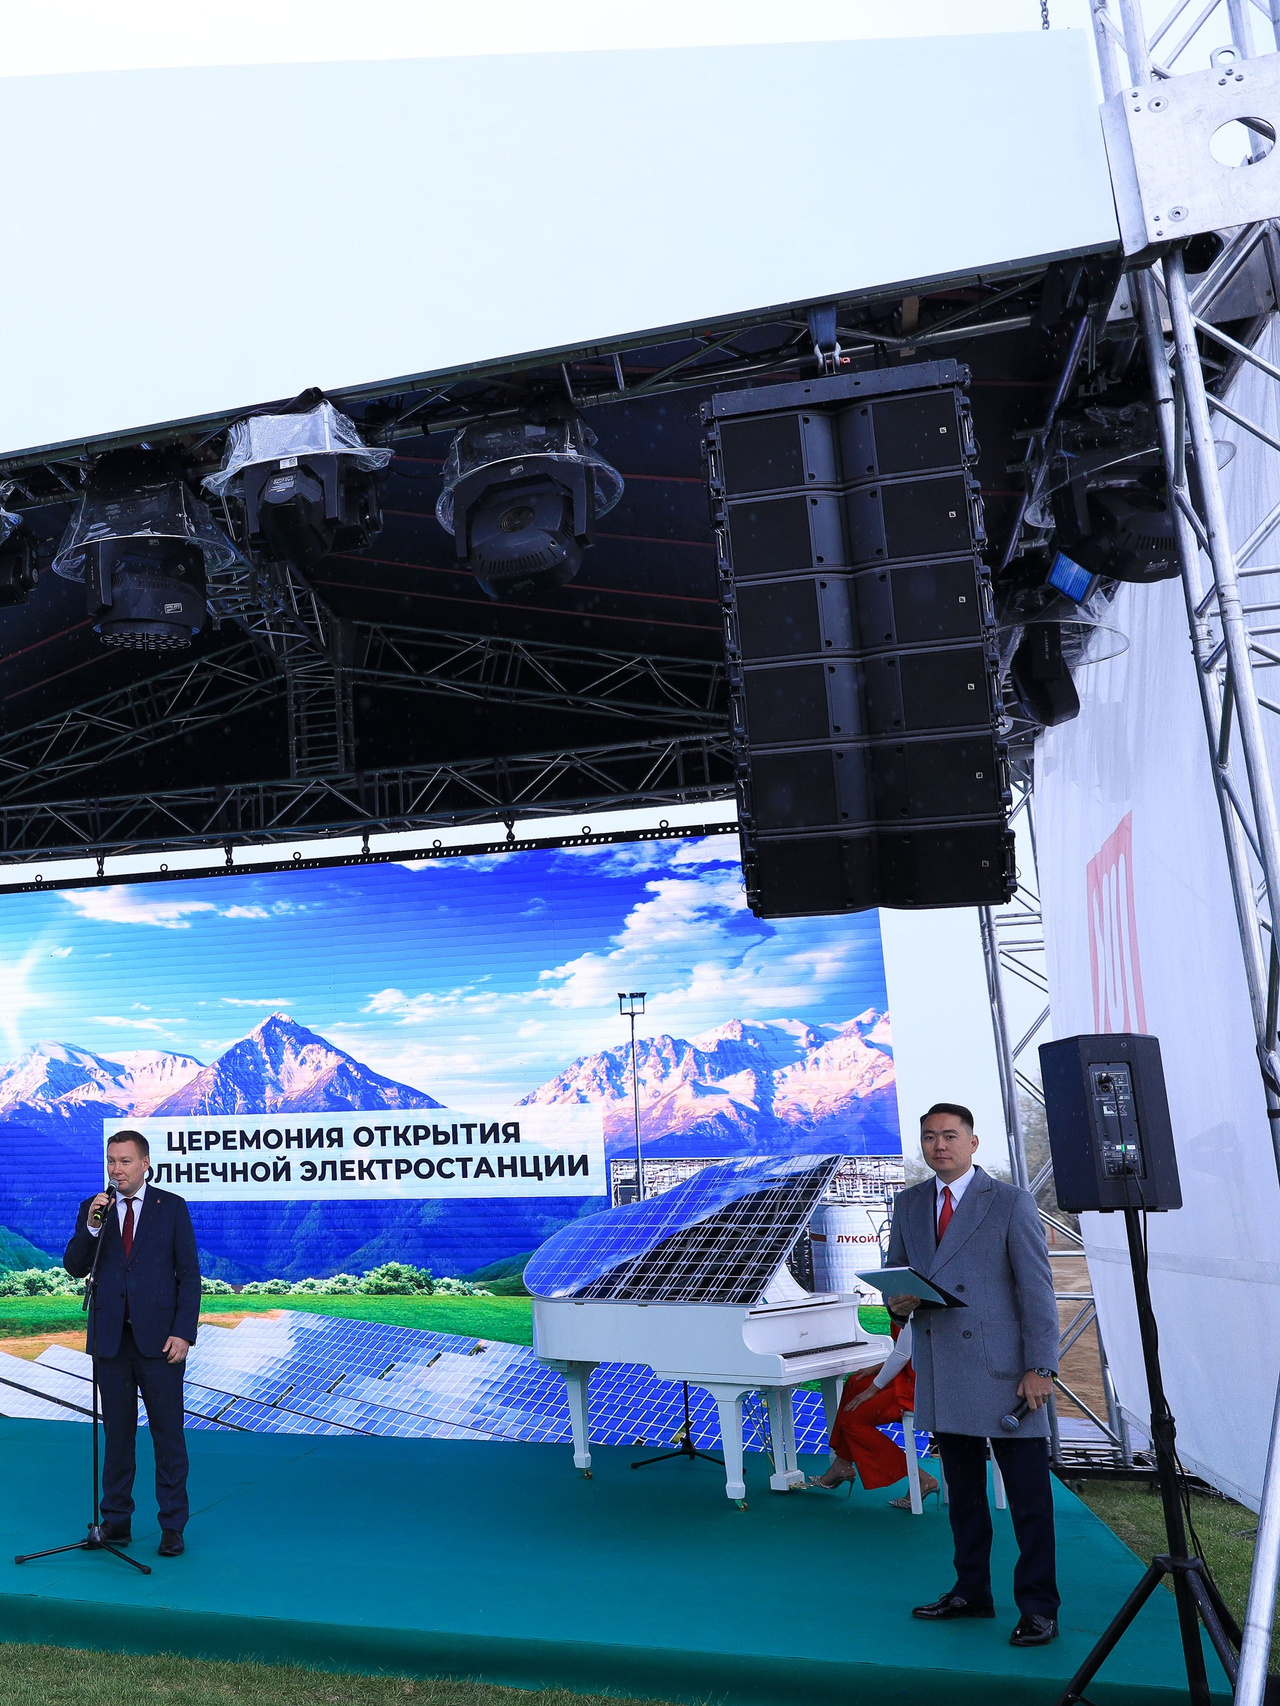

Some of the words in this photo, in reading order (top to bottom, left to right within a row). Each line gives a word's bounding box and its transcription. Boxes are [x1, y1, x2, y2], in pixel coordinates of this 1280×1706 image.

[167, 1127, 343, 1154] ЦЕРЕМОНИЯ
[353, 1122, 521, 1148] ОТКРЫТИЯ
[145, 1156, 291, 1184] ЛНЕЧНОЙ
[299, 1154, 589, 1182] ЭЛЕКТРОСТАНЦИИ
[836, 1234, 880, 1244] ЛУКОЙЛ
